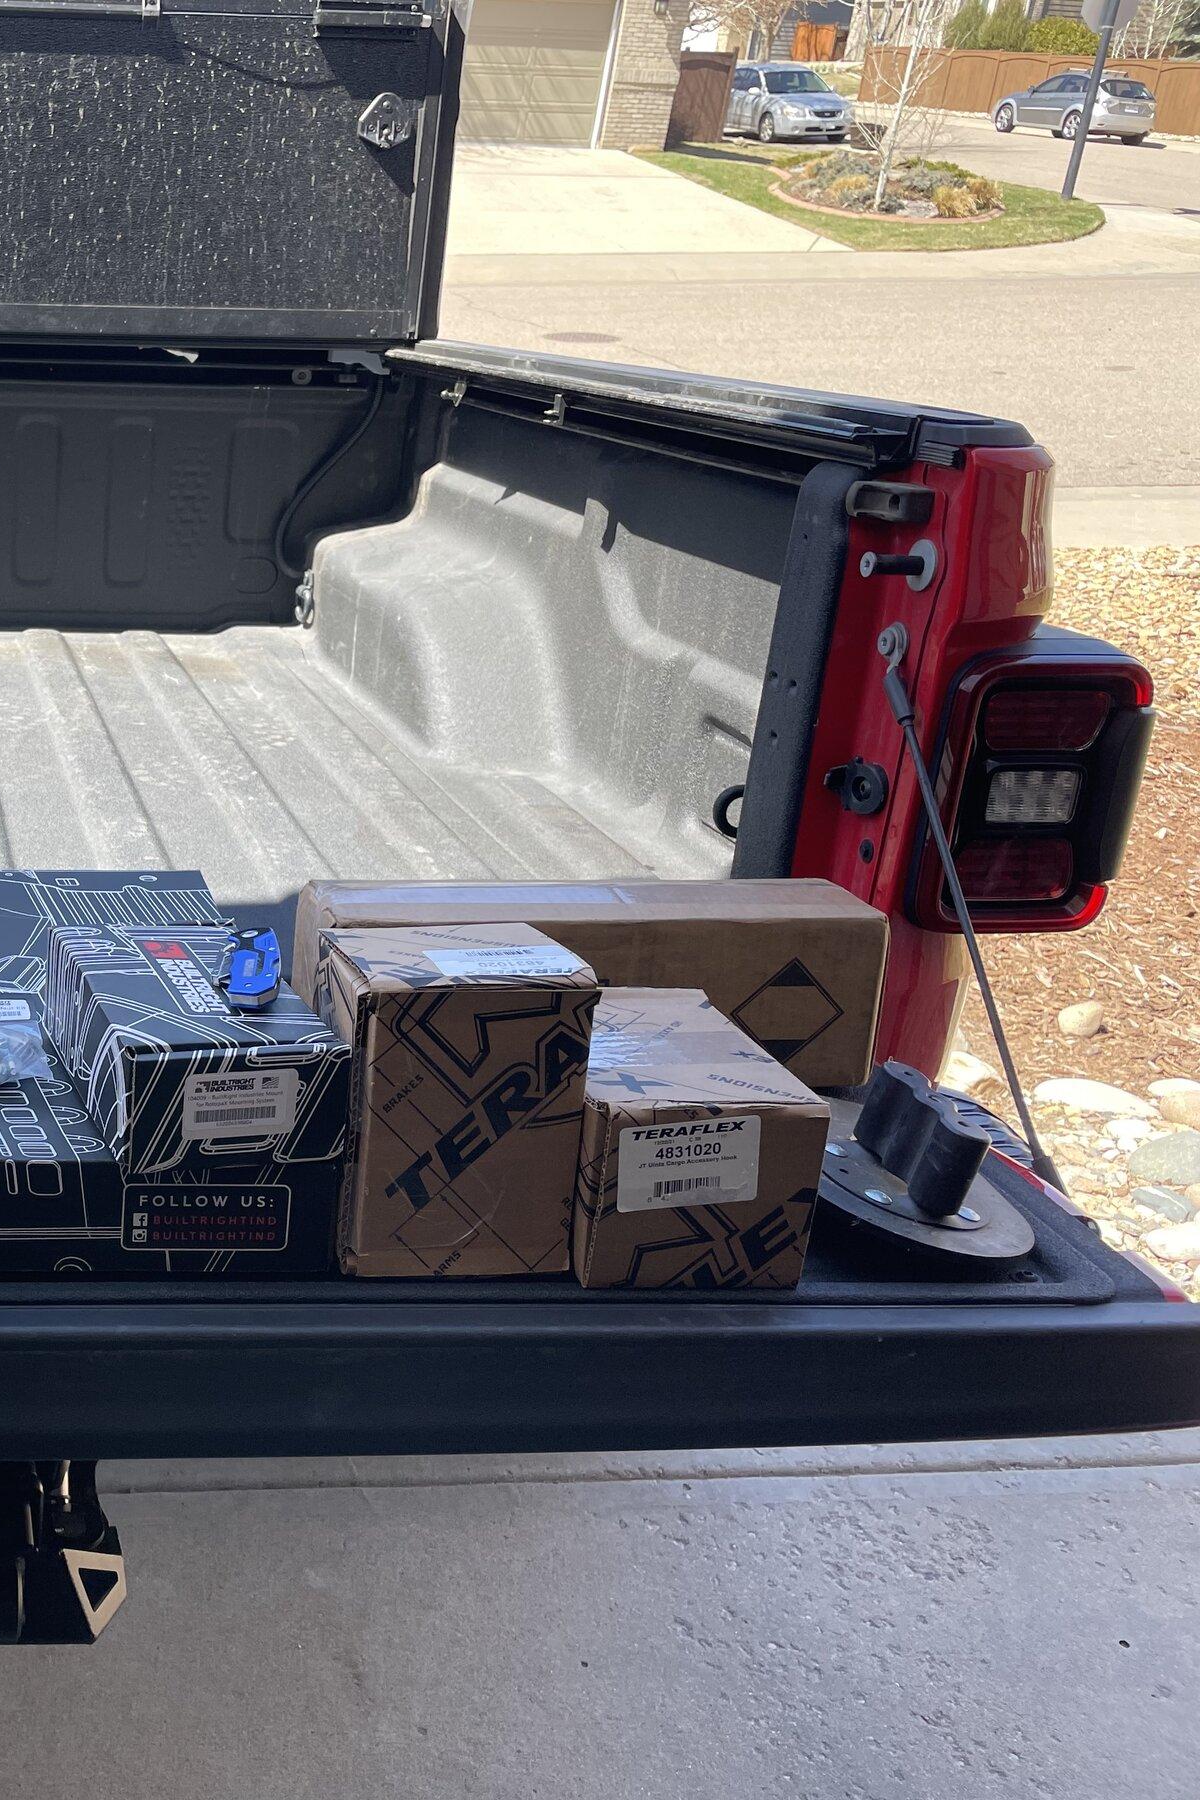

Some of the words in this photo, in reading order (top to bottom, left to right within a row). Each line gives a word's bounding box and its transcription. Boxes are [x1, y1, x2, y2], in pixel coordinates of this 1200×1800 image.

[155, 958, 210, 1013] INDUSTRIES
[173, 959, 232, 1014] BUILTRIGHT
[210, 1083, 254, 1093] INDUSTRIES
[211, 1078, 256, 1087] BUILTRIGHT
[382, 1074, 424, 1114] BRAKES
[385, 1031, 591, 1212] TERA
[632, 1120, 746, 1141] TERAFLEX
[655, 1142, 722, 1160] 4831020
[666, 1159, 685, 1167] Cargo
[139, 1195, 228, 1208] FOLLOW
[241, 1195, 275, 1208] US:
[152, 1215, 277, 1226] BUILTRIGHTIND
[152, 1231, 276, 1241] BUILTRIGHTIND
